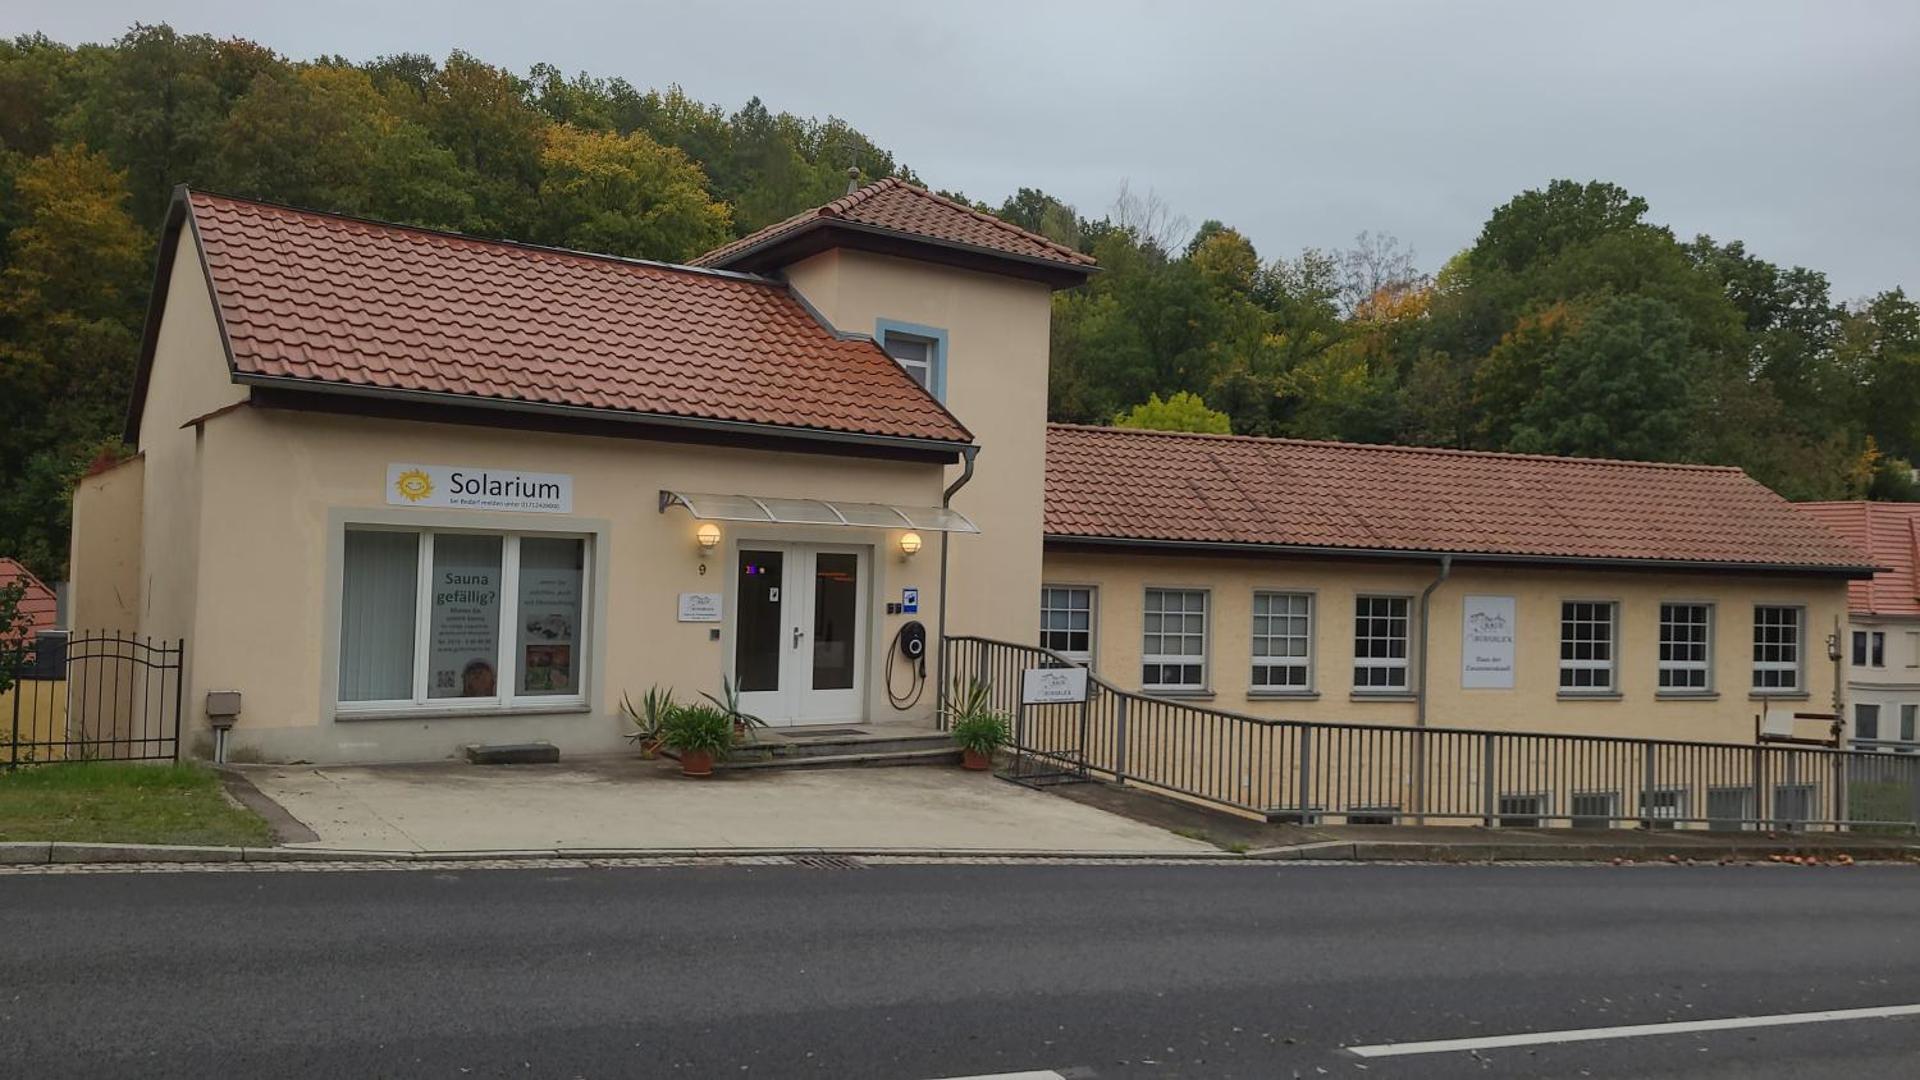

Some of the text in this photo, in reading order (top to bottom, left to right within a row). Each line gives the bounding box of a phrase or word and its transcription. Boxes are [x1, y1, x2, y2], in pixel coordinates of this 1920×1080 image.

[450, 472, 560, 500] Solarium
[698, 563, 707, 576] 9
[445, 572, 489, 586] Sauna
[437, 589, 496, 607] gefällig?
